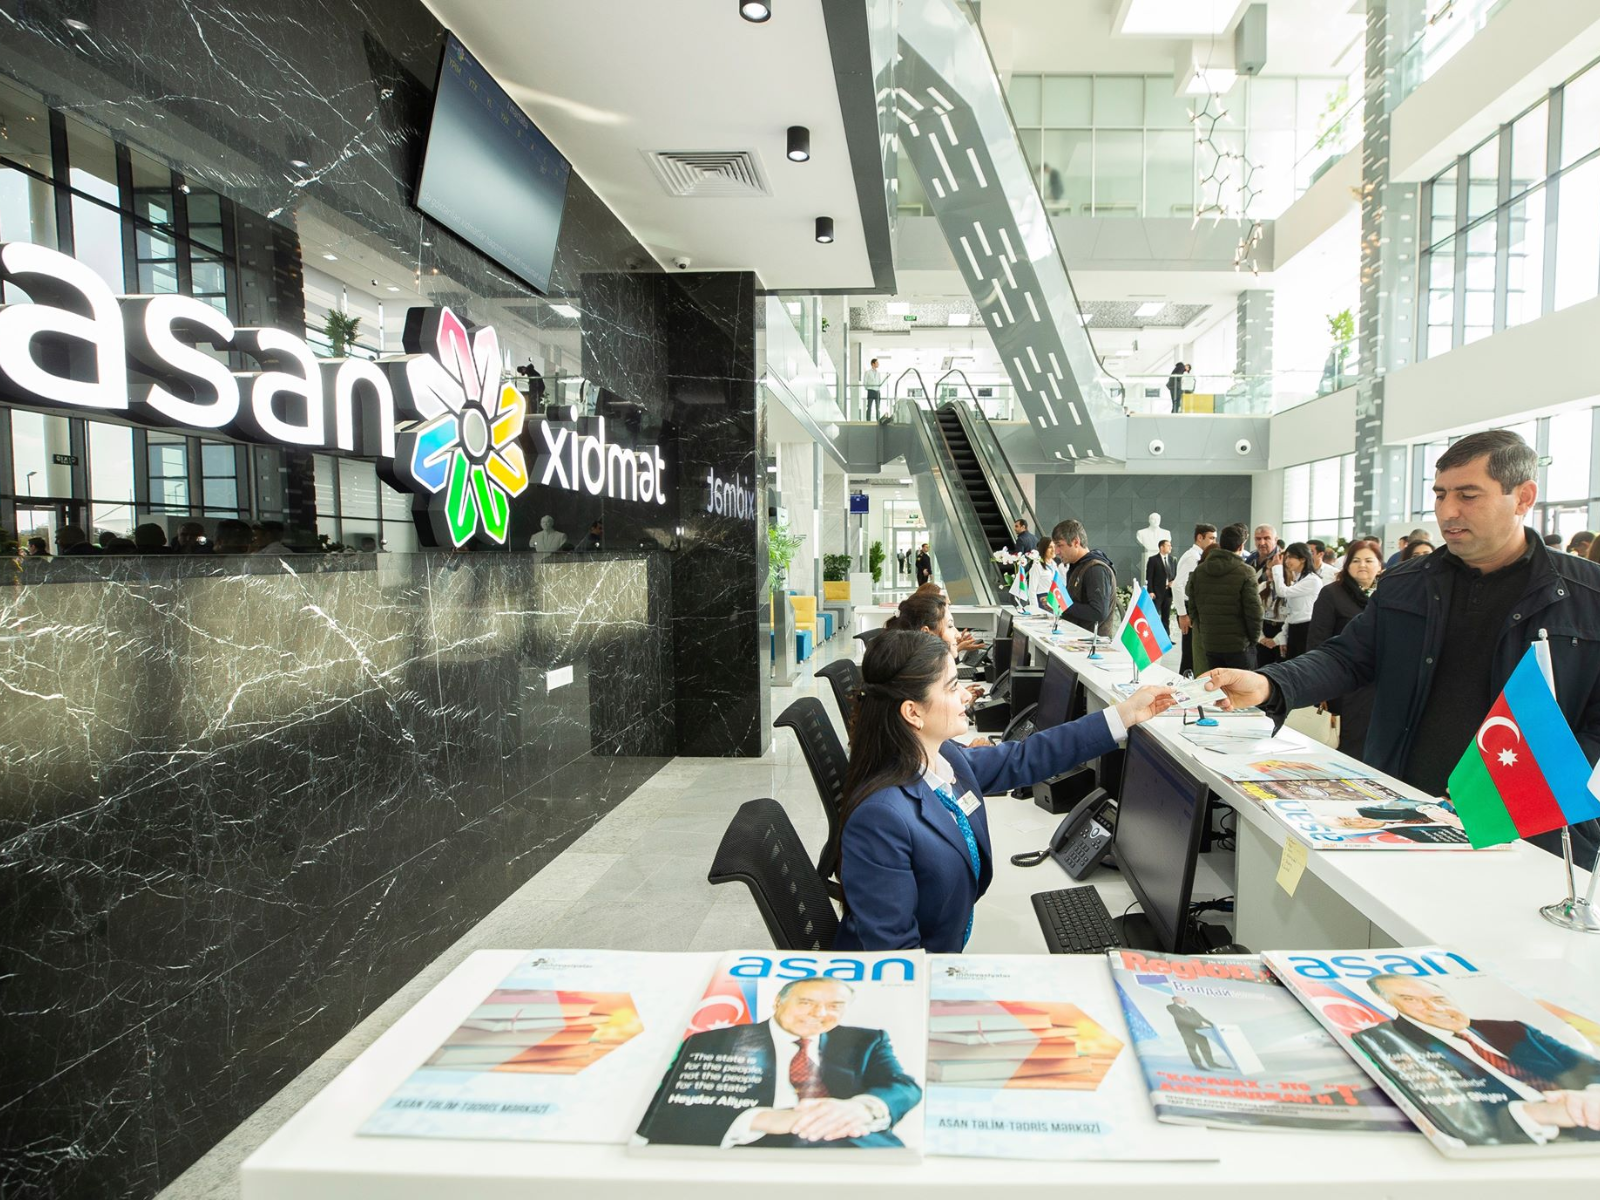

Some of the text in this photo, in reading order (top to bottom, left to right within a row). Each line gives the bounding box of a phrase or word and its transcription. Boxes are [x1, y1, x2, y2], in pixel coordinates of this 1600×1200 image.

[0, 241, 395, 458] asan
[540, 405, 667, 505] xidmət
[729, 956, 915, 982] asan
[1120, 951, 1256, 981] Region
[1287, 950, 1479, 979] asan
[1172, 981, 1232, 997] Валдай
[715, 1053, 746, 1064] state
[684, 1062, 701, 1071] for
[702, 1062, 722, 1072] the
[679, 1071, 763, 1084] not the people
[675, 1081, 694, 1090] for
[694, 1081, 715, 1091] the
[938, 1118, 968, 1129] ASAN
